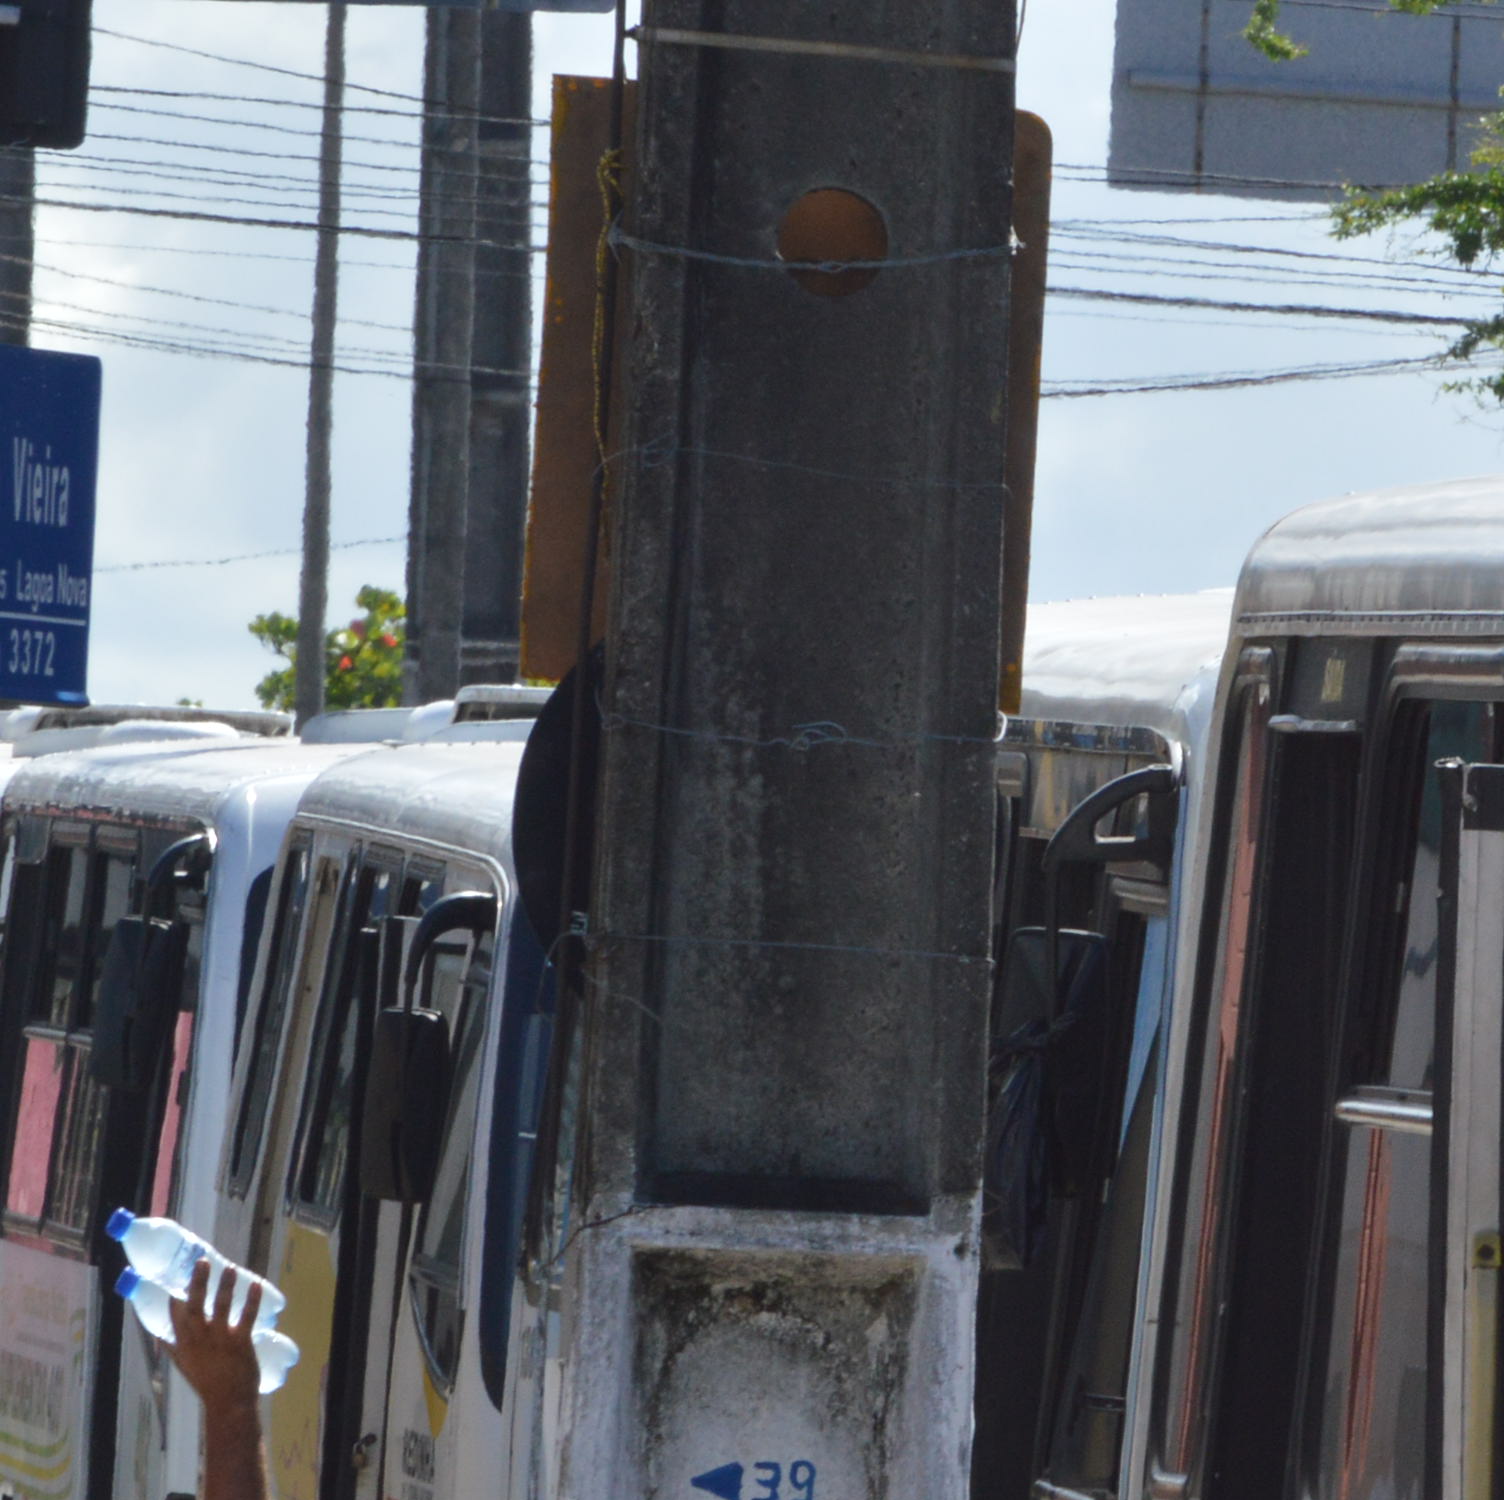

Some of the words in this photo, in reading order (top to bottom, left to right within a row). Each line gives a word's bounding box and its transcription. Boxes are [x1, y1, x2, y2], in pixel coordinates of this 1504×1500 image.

[13, 437, 71, 527] Vieira
[16, 560, 54, 612] Lagoa
[57, 563, 88, 608] Nova
[8, 629, 55, 676] 3372
